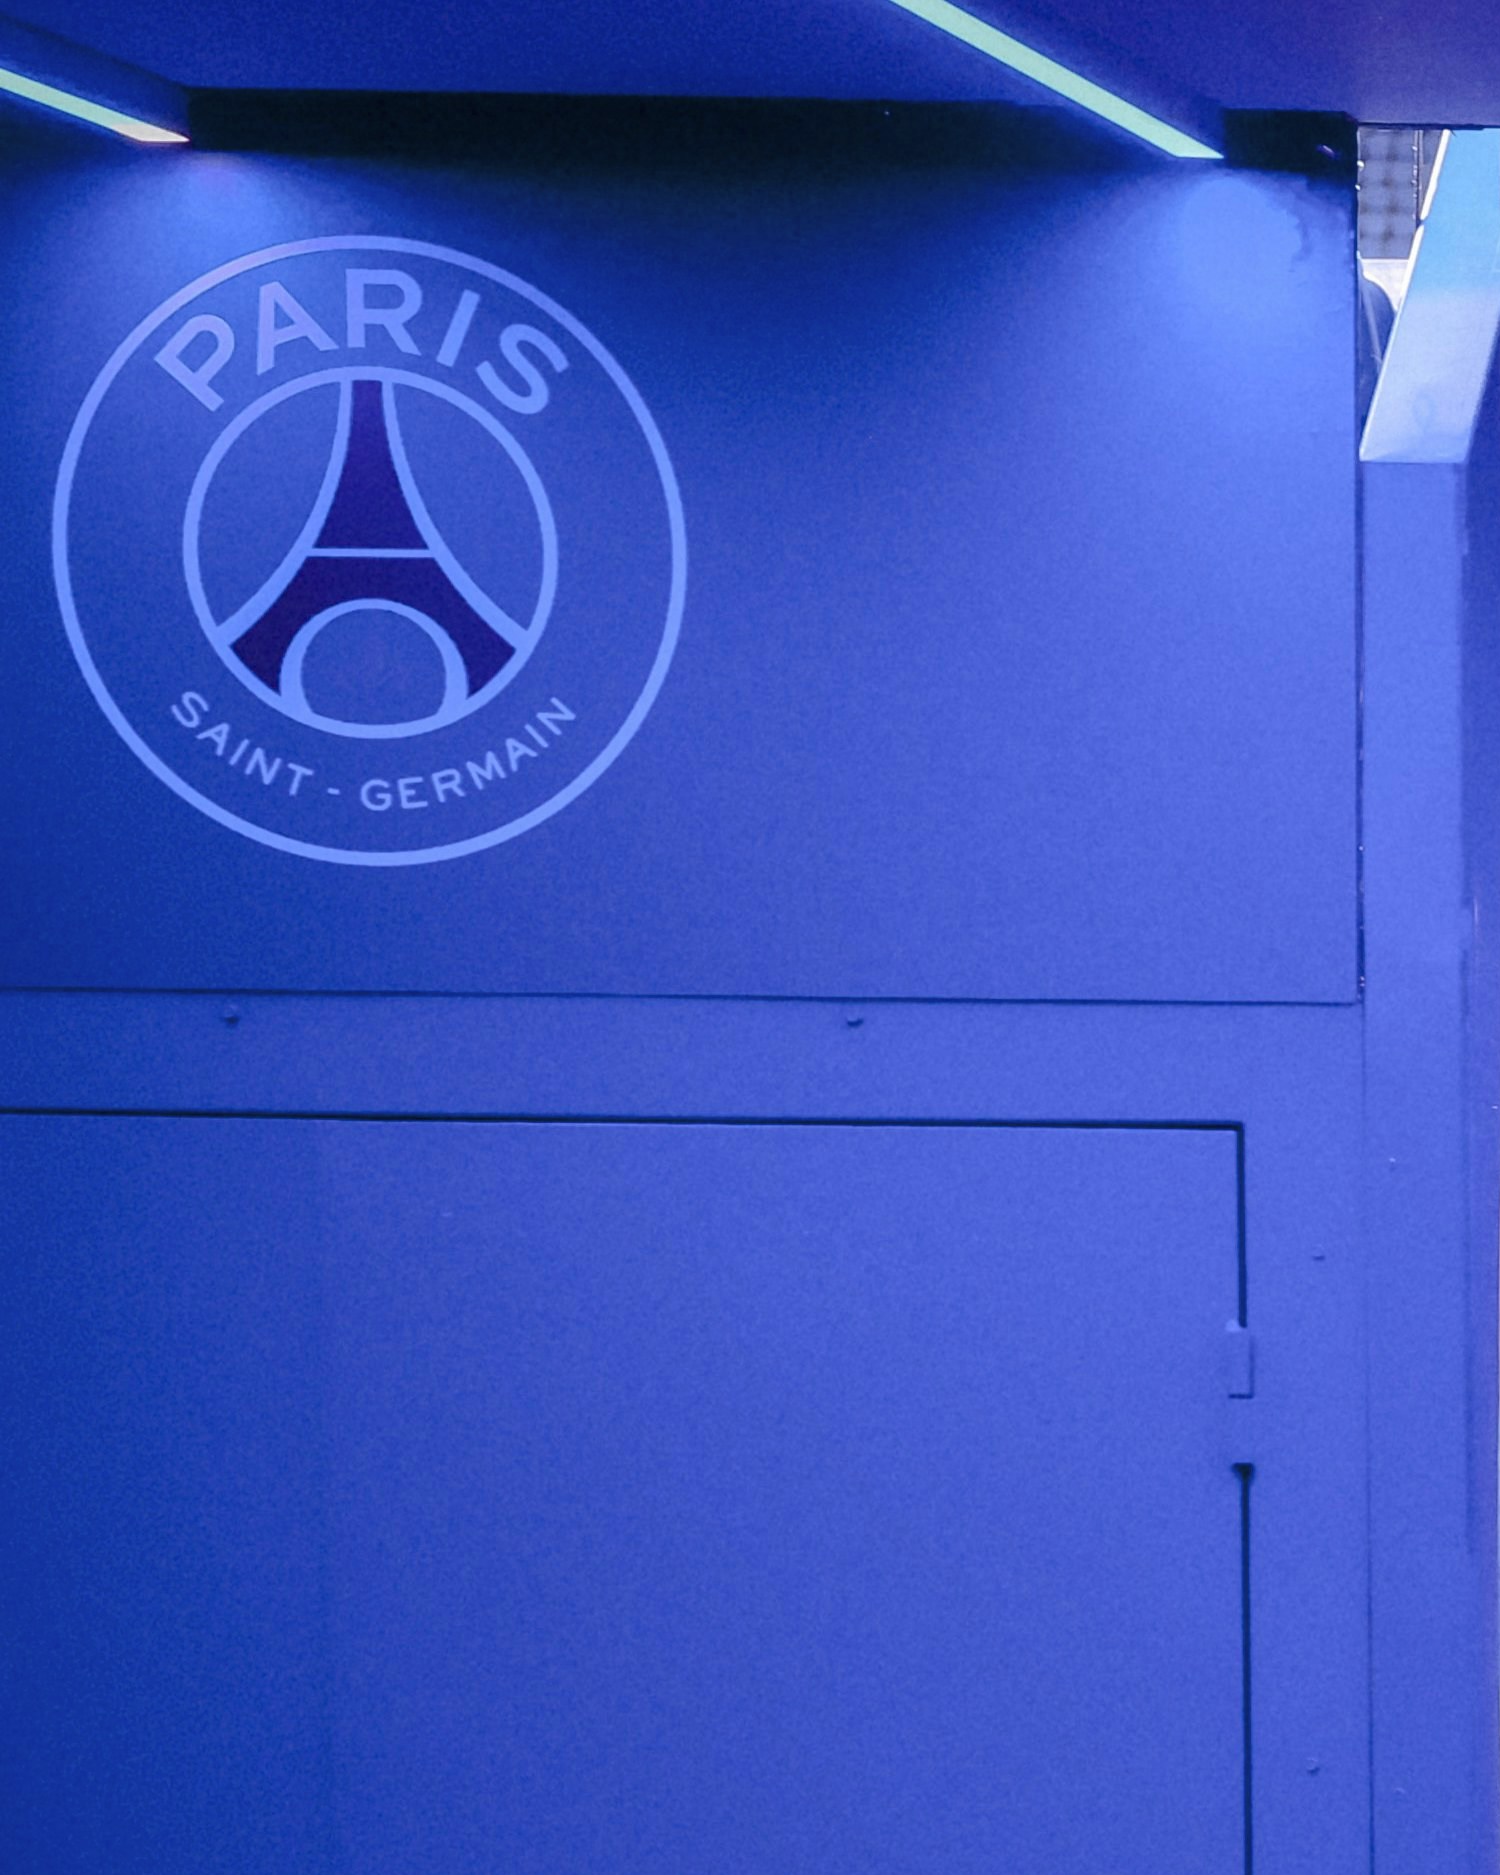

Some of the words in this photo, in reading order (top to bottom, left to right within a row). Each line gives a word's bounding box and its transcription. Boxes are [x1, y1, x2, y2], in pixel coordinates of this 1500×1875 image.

[153, 268, 569, 415] PARIS
[171, 690, 315, 797] SAINT
[360, 696, 576, 812] GERMAIN
